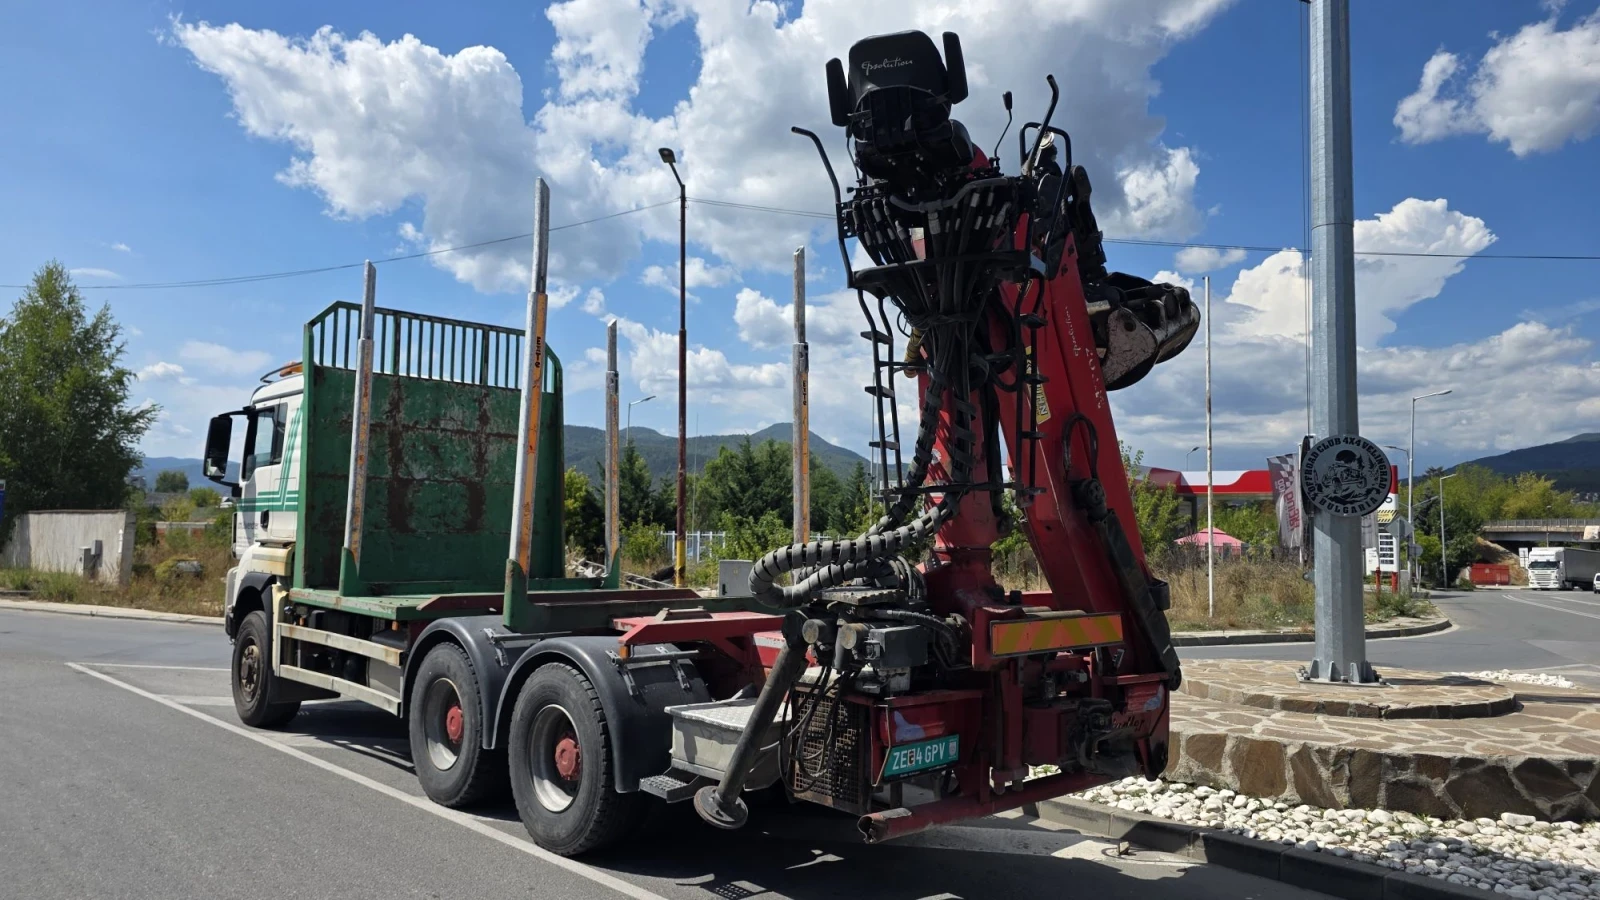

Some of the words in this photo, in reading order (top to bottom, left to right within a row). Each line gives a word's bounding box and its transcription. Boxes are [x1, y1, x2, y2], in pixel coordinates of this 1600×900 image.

[1304, 451, 1320, 491] OFFROAD
[1316, 437, 1342, 453] CLUB
[1361, 441, 1388, 490] VELINGRAD
[1318, 496, 1379, 514] BULGARIA
